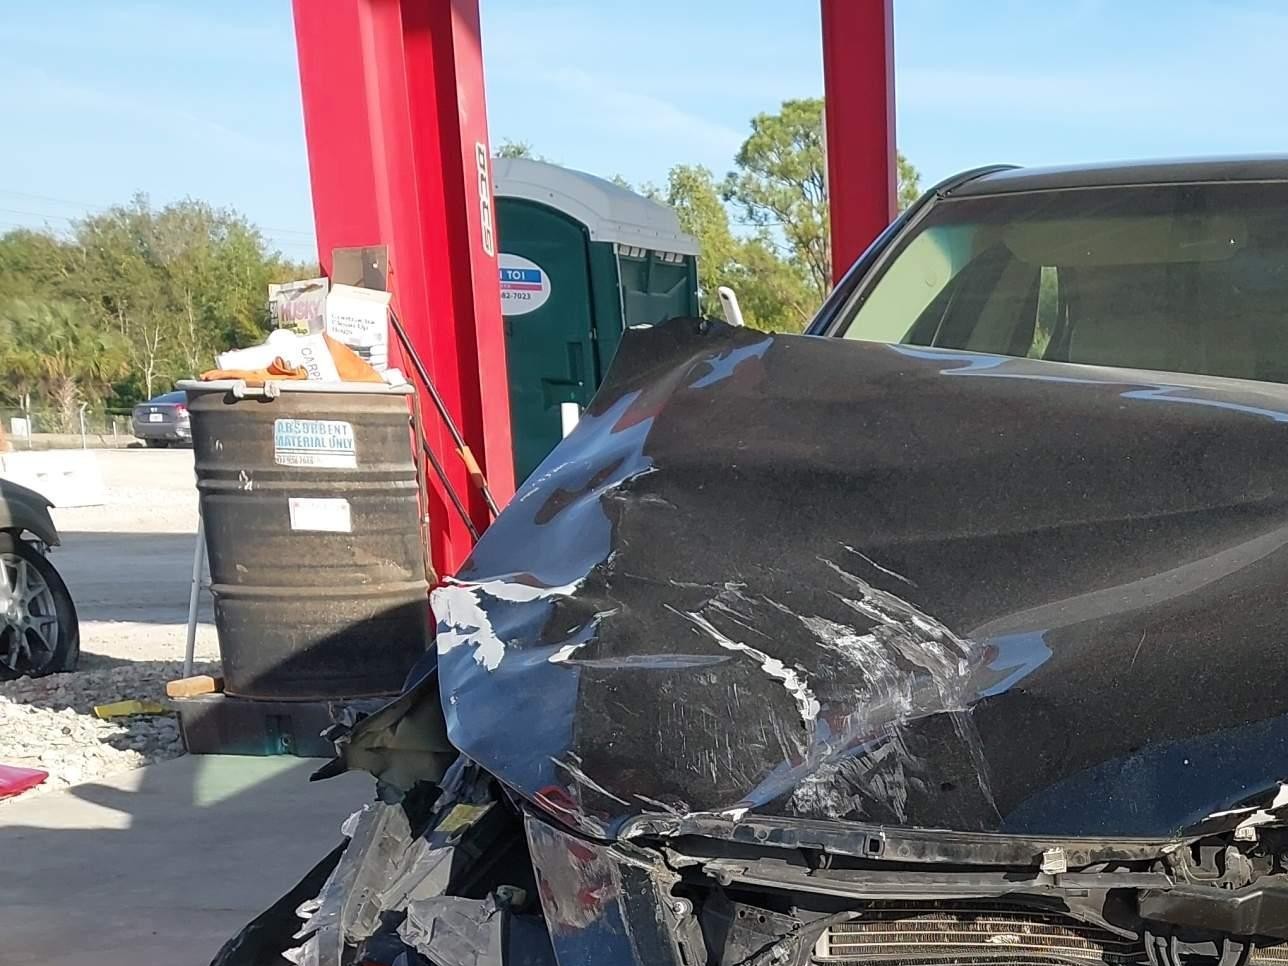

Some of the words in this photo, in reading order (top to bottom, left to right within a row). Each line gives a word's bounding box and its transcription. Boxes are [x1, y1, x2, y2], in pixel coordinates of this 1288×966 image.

[277, 421, 348, 435] ABSORBENT
[276, 435, 326, 449] MATERIAL
[328, 437, 353, 449] ONLY
